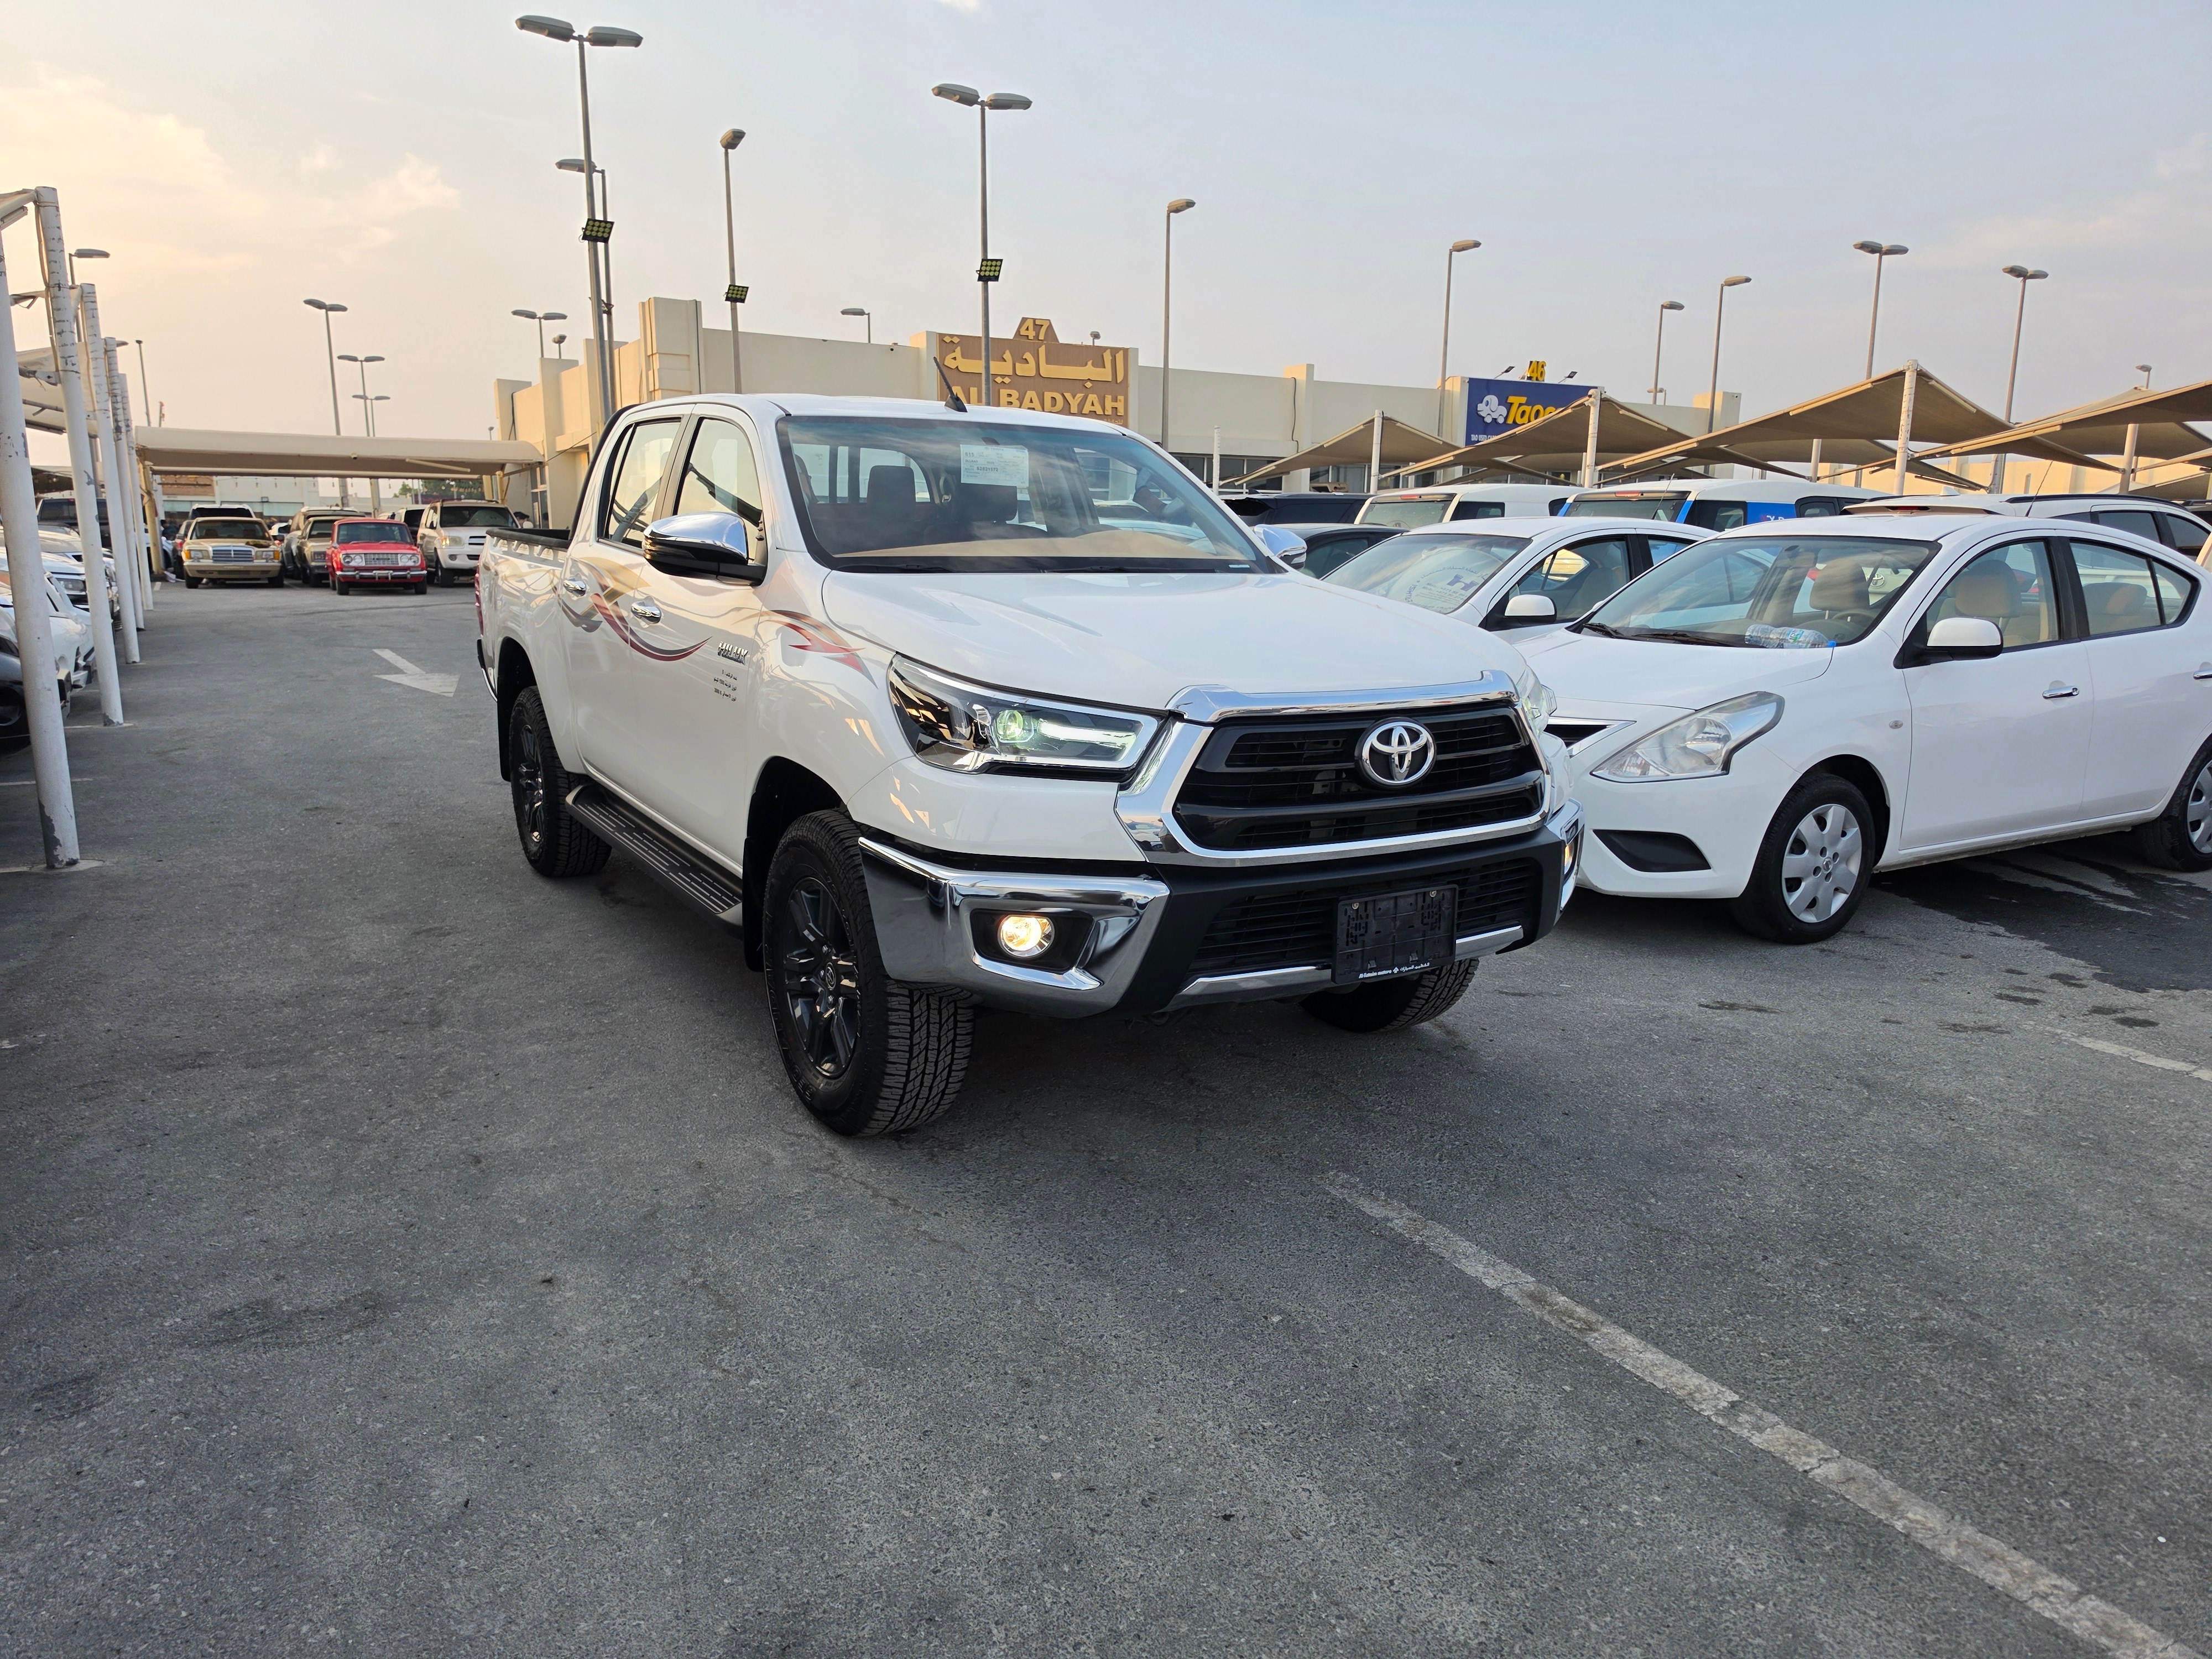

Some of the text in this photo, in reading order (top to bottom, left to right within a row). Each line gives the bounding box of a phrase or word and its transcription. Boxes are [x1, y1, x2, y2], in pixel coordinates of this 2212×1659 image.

[1020, 319, 1050, 340] 47
[943, 335, 1124, 389] البادية
[1527, 361, 1547, 382] 46
[946, 385, 1124, 416] AL BADYAH
[1506, 395, 1563, 424] Taoc
[717, 641, 749, 665] HILUX
